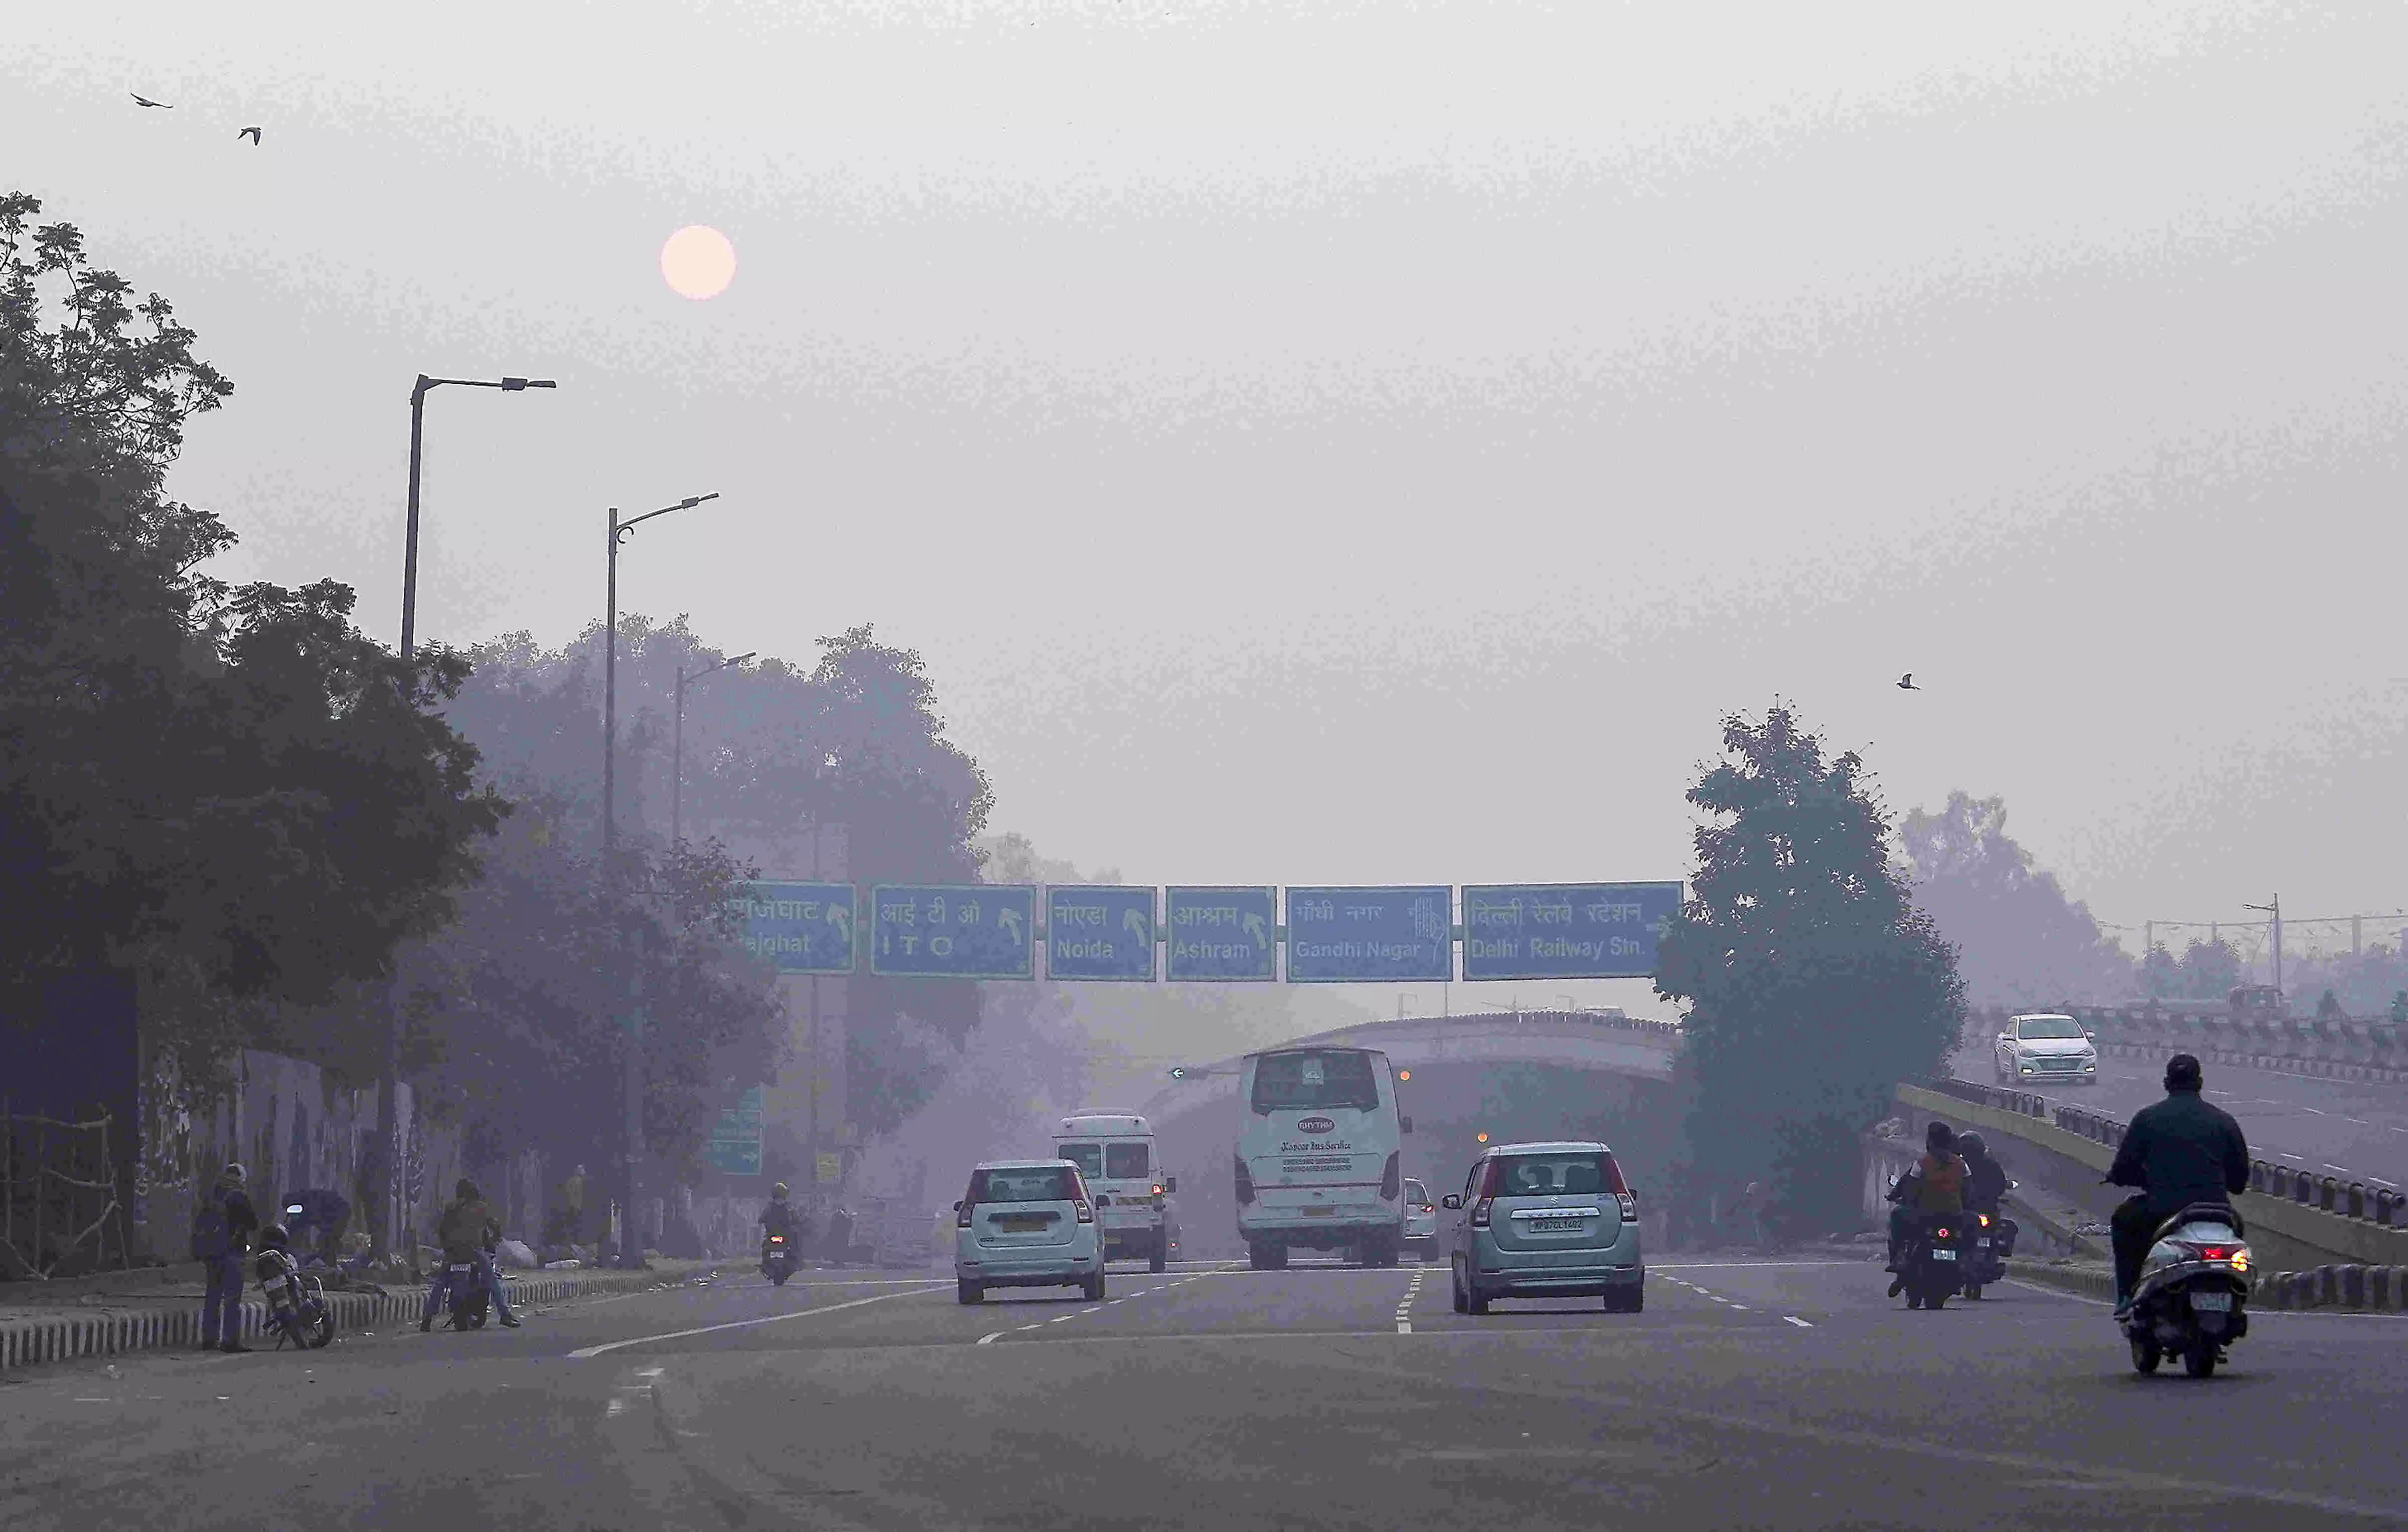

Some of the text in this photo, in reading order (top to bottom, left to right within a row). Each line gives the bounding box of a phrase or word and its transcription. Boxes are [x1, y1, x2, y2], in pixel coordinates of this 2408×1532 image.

[880, 897, 916, 927] आई
[927, 896, 946, 924] टी
[1054, 900, 1107, 928] नोएडा
[1171, 904, 1239, 927] आश्रम
[1344, 905, 1384, 922] नगर
[1471, 896, 1642, 929] दिल्ली रेलवे स्टेशन
[1058, 939, 1113, 960] Noida
[1171, 939, 1250, 959] Ashram
[1296, 940, 1421, 962] Gandhi Nagar
[1471, 938, 1520, 959] Delhi
[1531, 936, 1604, 961] Railway
[1298, 1121, 1333, 1130] RHYTHM
